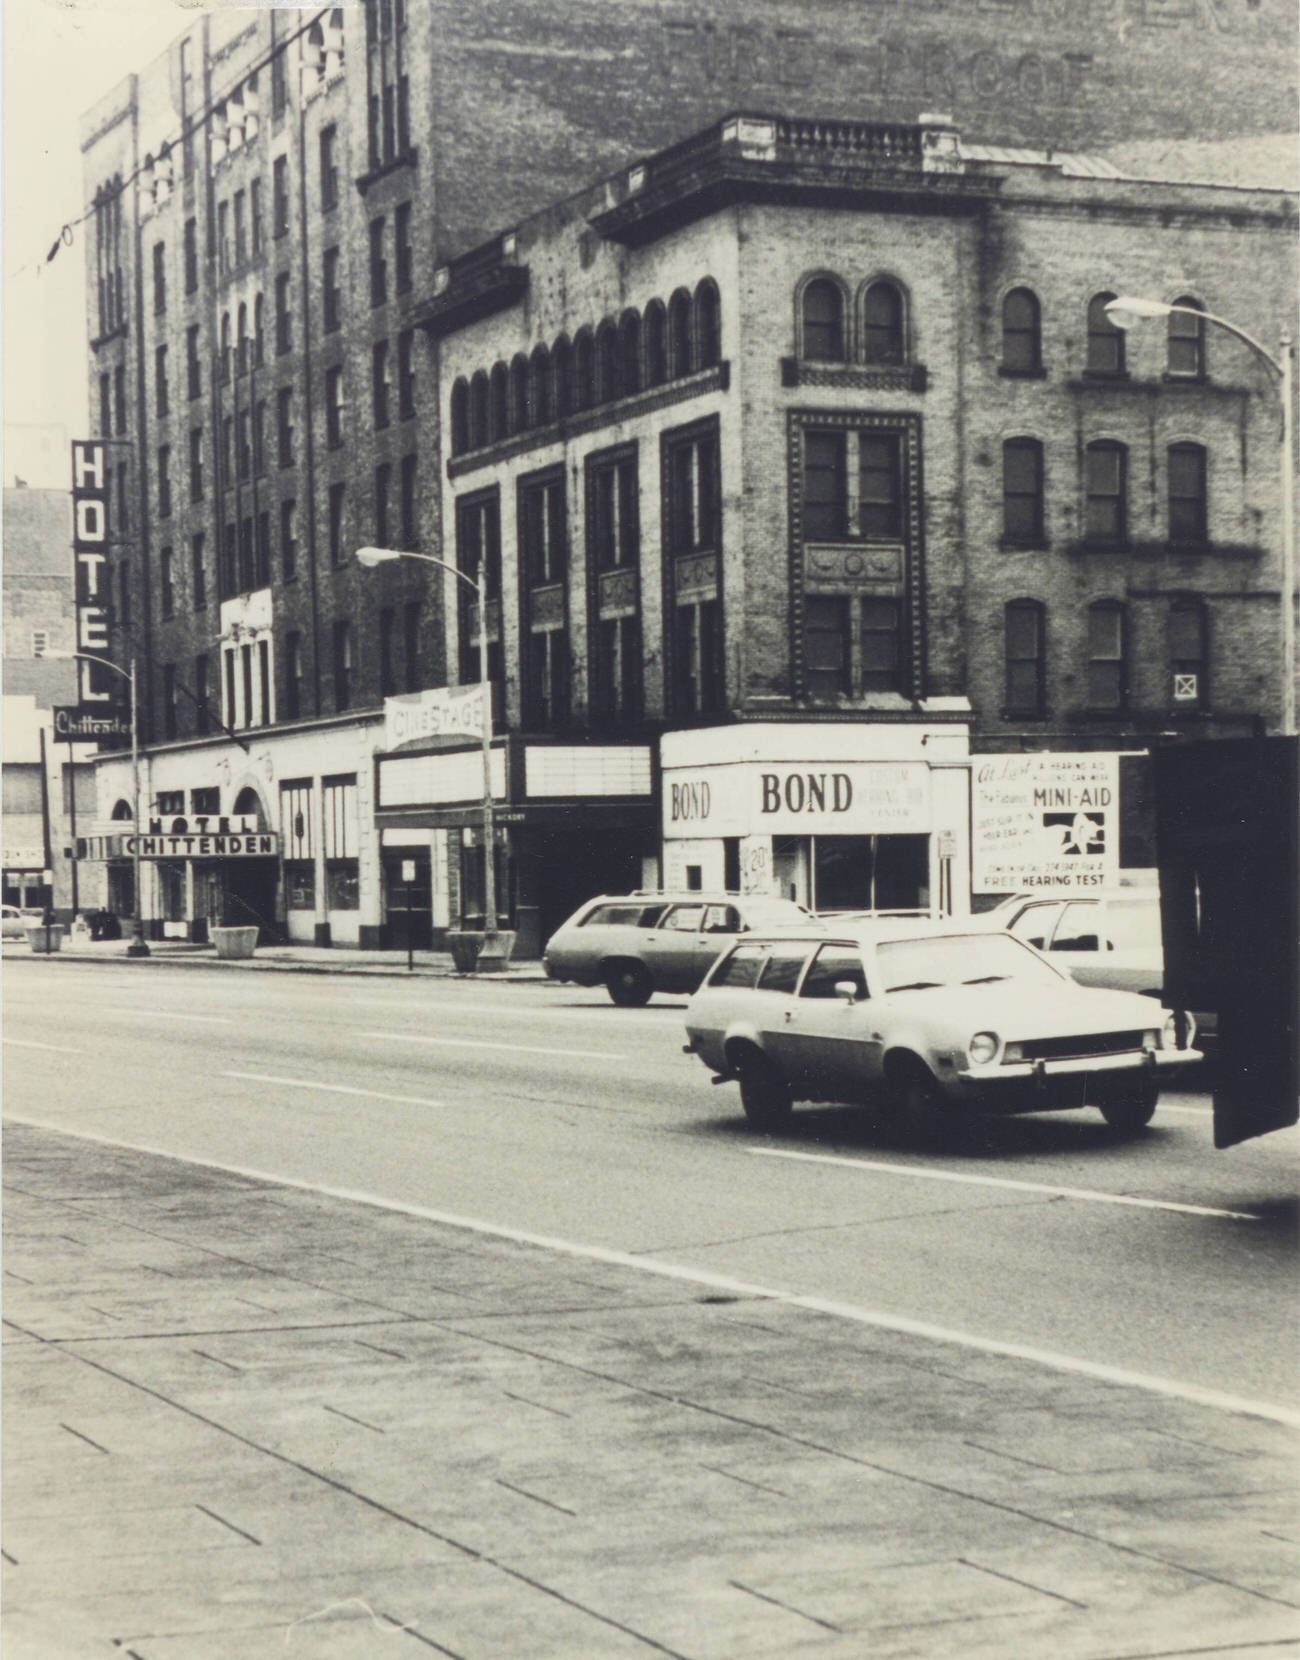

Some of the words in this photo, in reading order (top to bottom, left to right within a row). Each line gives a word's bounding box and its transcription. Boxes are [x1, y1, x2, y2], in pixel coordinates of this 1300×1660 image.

[74, 445, 110, 702] HOTEL
[56, 710, 134, 734] Chittende
[671, 781, 711, 821] BOND
[760, 773, 853, 814] BOND
[1034, 787, 1112, 807] MINI-AID
[149, 817, 253, 834] HOTEL
[126, 836, 272, 856] CHITTENDEN
[984, 877, 1016, 888] FREE
[1022, 875, 1071, 887] HEARING
[1076, 874, 1105, 886] TEST
